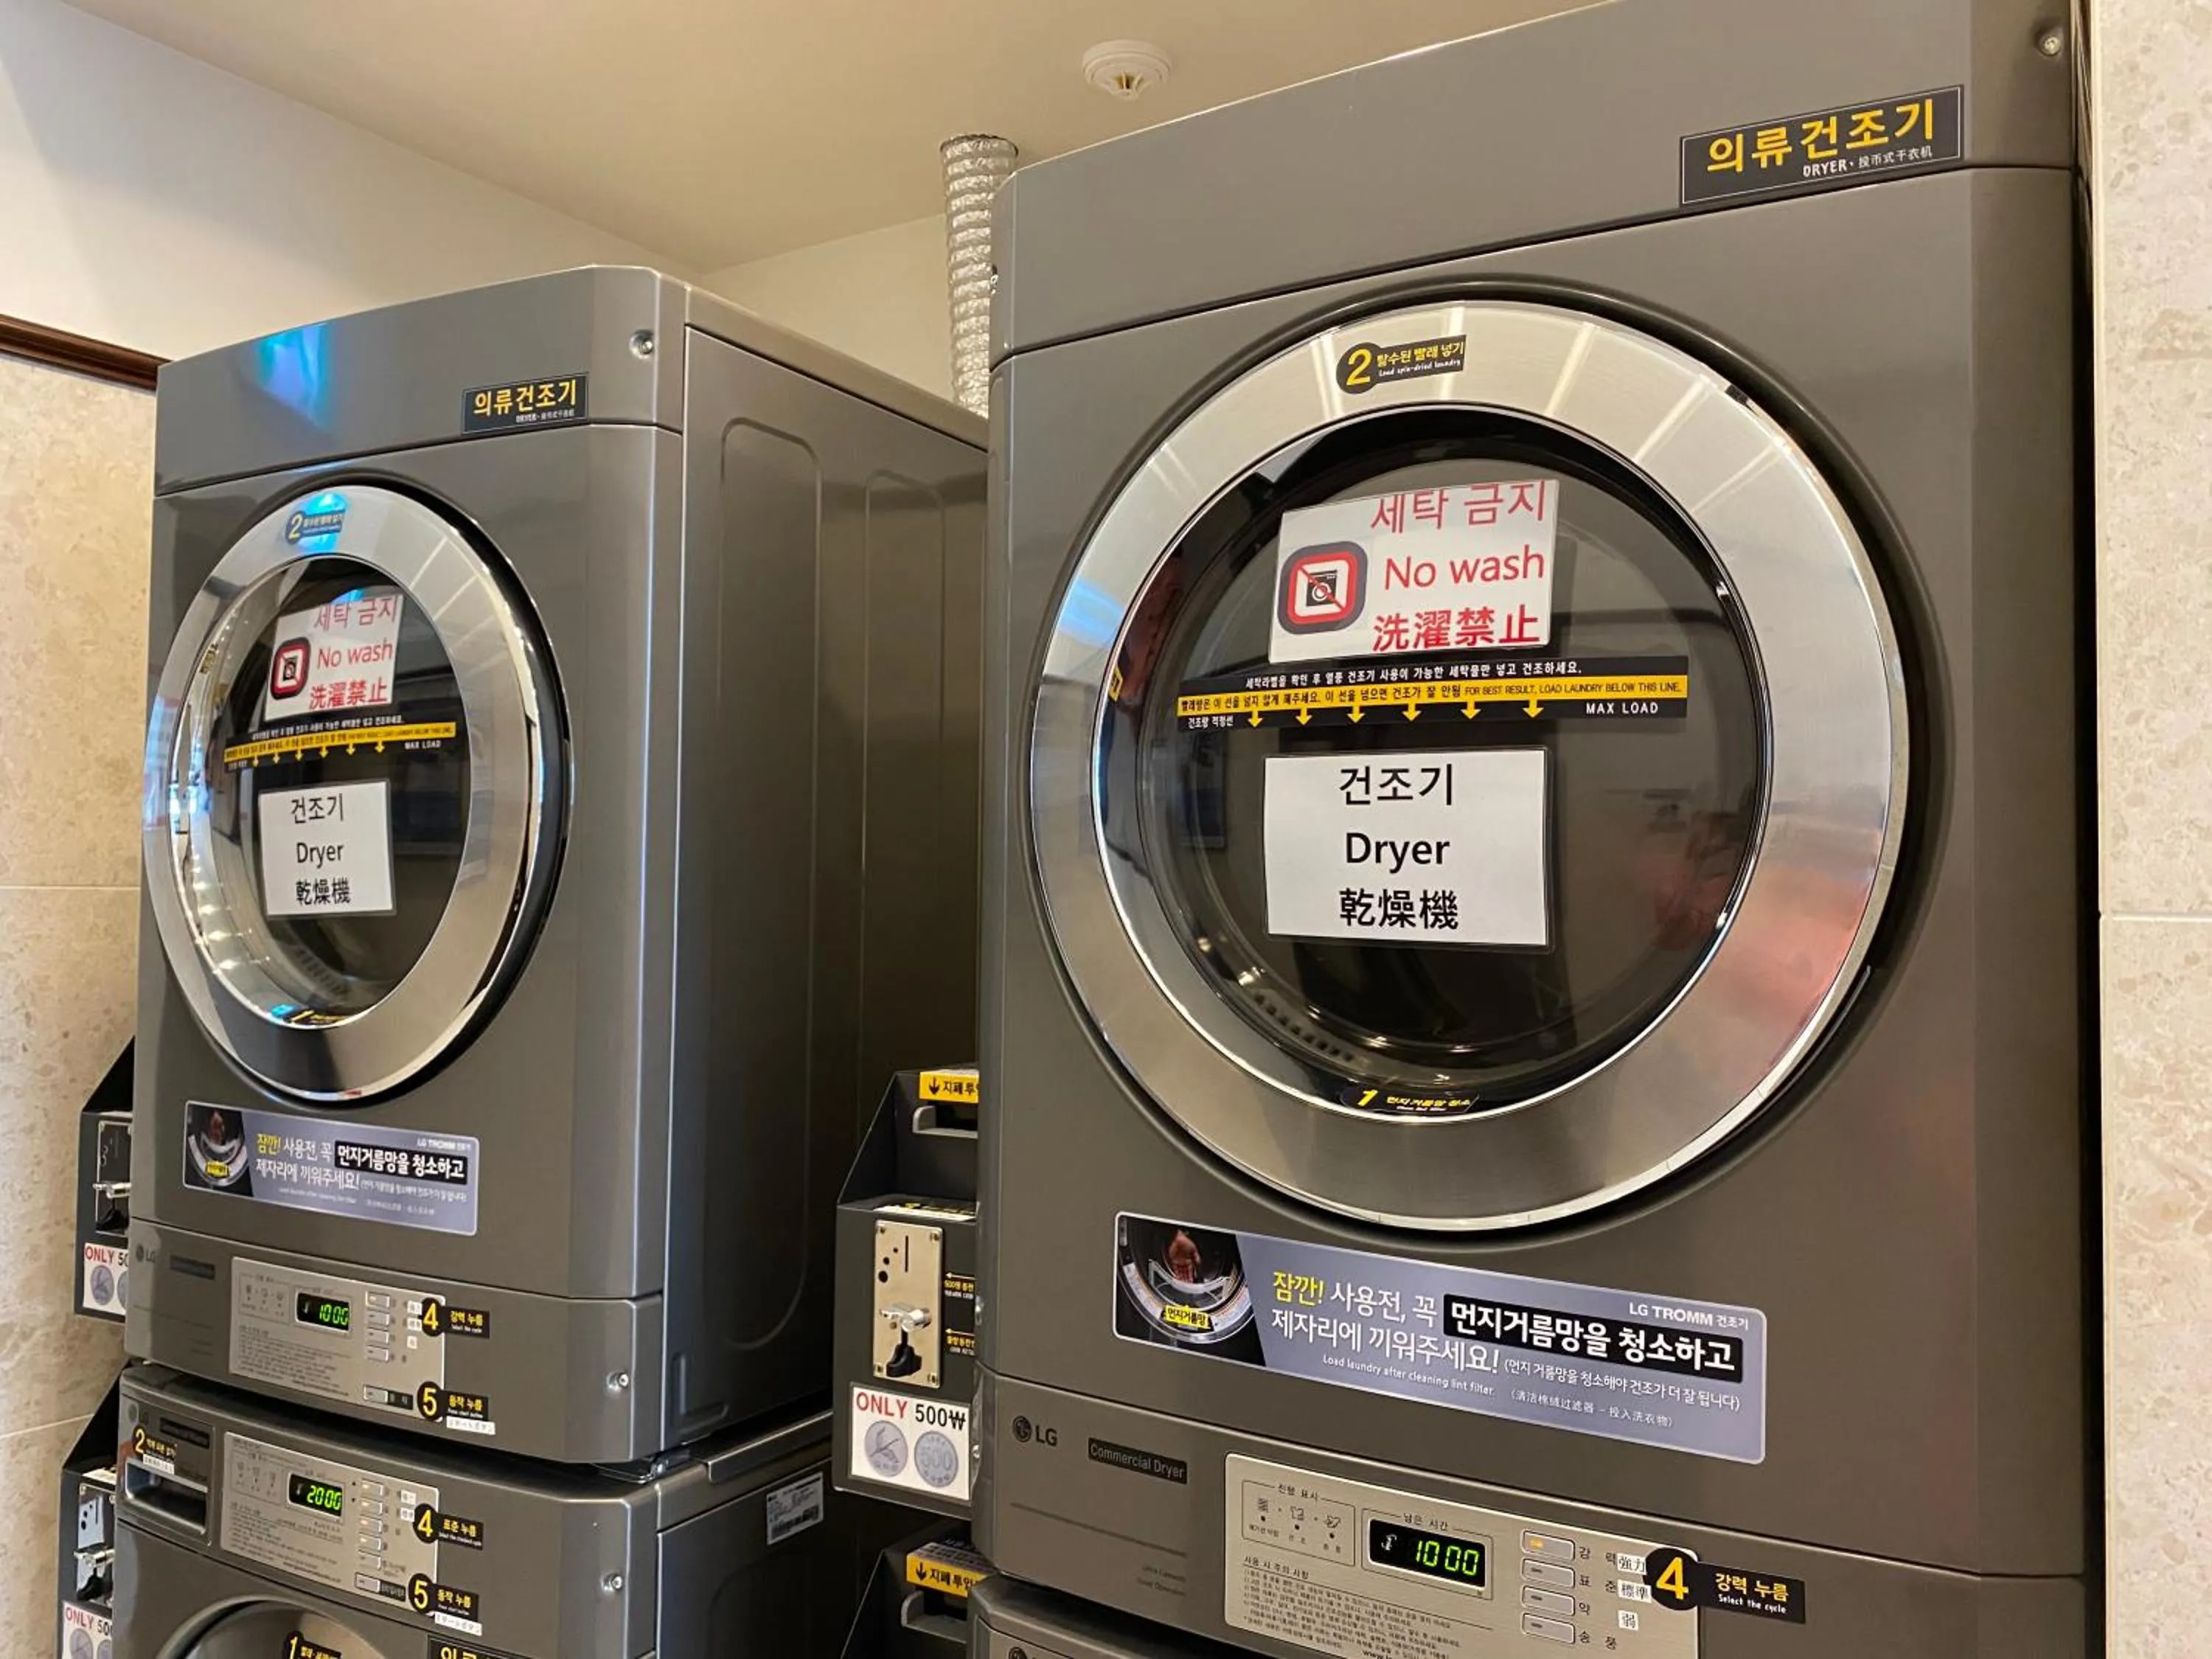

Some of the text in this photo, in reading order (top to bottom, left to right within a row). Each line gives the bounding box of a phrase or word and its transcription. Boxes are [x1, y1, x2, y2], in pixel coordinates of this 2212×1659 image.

[1707, 98, 1933, 173] 의류건조기
[1346, 348, 1372, 386] 2
[473, 378, 577, 417] 의류건조기
[1370, 479, 1545, 534] 세탁 금지
[1384, 543, 1544, 591] No wash
[313, 596, 398, 632] 세탁 금지
[1371, 603, 1540, 653] 洗濯禁止
[317, 637, 392, 670] No wash
[1347, 669, 1375, 684] 건조기
[1482, 685, 1502, 695] BEST
[1539, 684, 1562, 695] LOAD
[1564, 683, 1602, 694] LAUNDRY
[1606, 682, 1635, 693] BELOW
[1638, 682, 1657, 692] THIS
[308, 676, 387, 710] 洗濯禁止
[1586, 701, 1659, 714] MAX LOAD
[1338, 763, 1453, 806] 건조기
[291, 793, 344, 824] 건조기
[296, 842, 344, 869] Dryer
[1346, 832, 1450, 874] Dryer
[296, 877, 351, 906] 乾燥機
[1339, 887, 1459, 930] 乾燥機
[337, 1144, 409, 1175] 먼지거름망을
[412, 1154, 465, 1179] 청소하고
[86, 1245, 114, 1263] ONLY
[422, 1303, 439, 1330] 4
[1273, 1270, 1326, 1307] 잠깐!
[1412, 1294, 1439, 1326] 꼭
[1451, 1301, 1610, 1357] 먼지거름망을
[1618, 1326, 1735, 1371] 청소하고
[1629, 1301, 1649, 1317] LG
[1652, 1305, 1713, 1326] TROMM
[1271, 1309, 1362, 1352] 제자리에
[1368, 1326, 1500, 1374] 끼워주세요!
[1669, 1384, 1680, 1400] 더
[1323, 1354, 1344, 1367] Load
[1347, 1357, 1382, 1376] laundry
[1383, 1366, 1406, 1380] after
[1408, 1371, 1448, 1389] cleaning
[422, 1387, 437, 1416] 5
[856, 1391, 908, 1419] ONLY
[135, 1428, 145, 1454] 2
[1035, 1425, 1058, 1447] LG
[1090, 1442, 1185, 1478] Commercial Dryer
[417, 1509, 434, 1538] 4
[1655, 1556, 1689, 1600] 4
[1715, 1573, 1790, 1602] 강력 누름
[414, 1579, 428, 1610] 5
[1718, 1593, 1787, 1614] Select the cycle
[65, 1607, 112, 1636] ONLY 50
